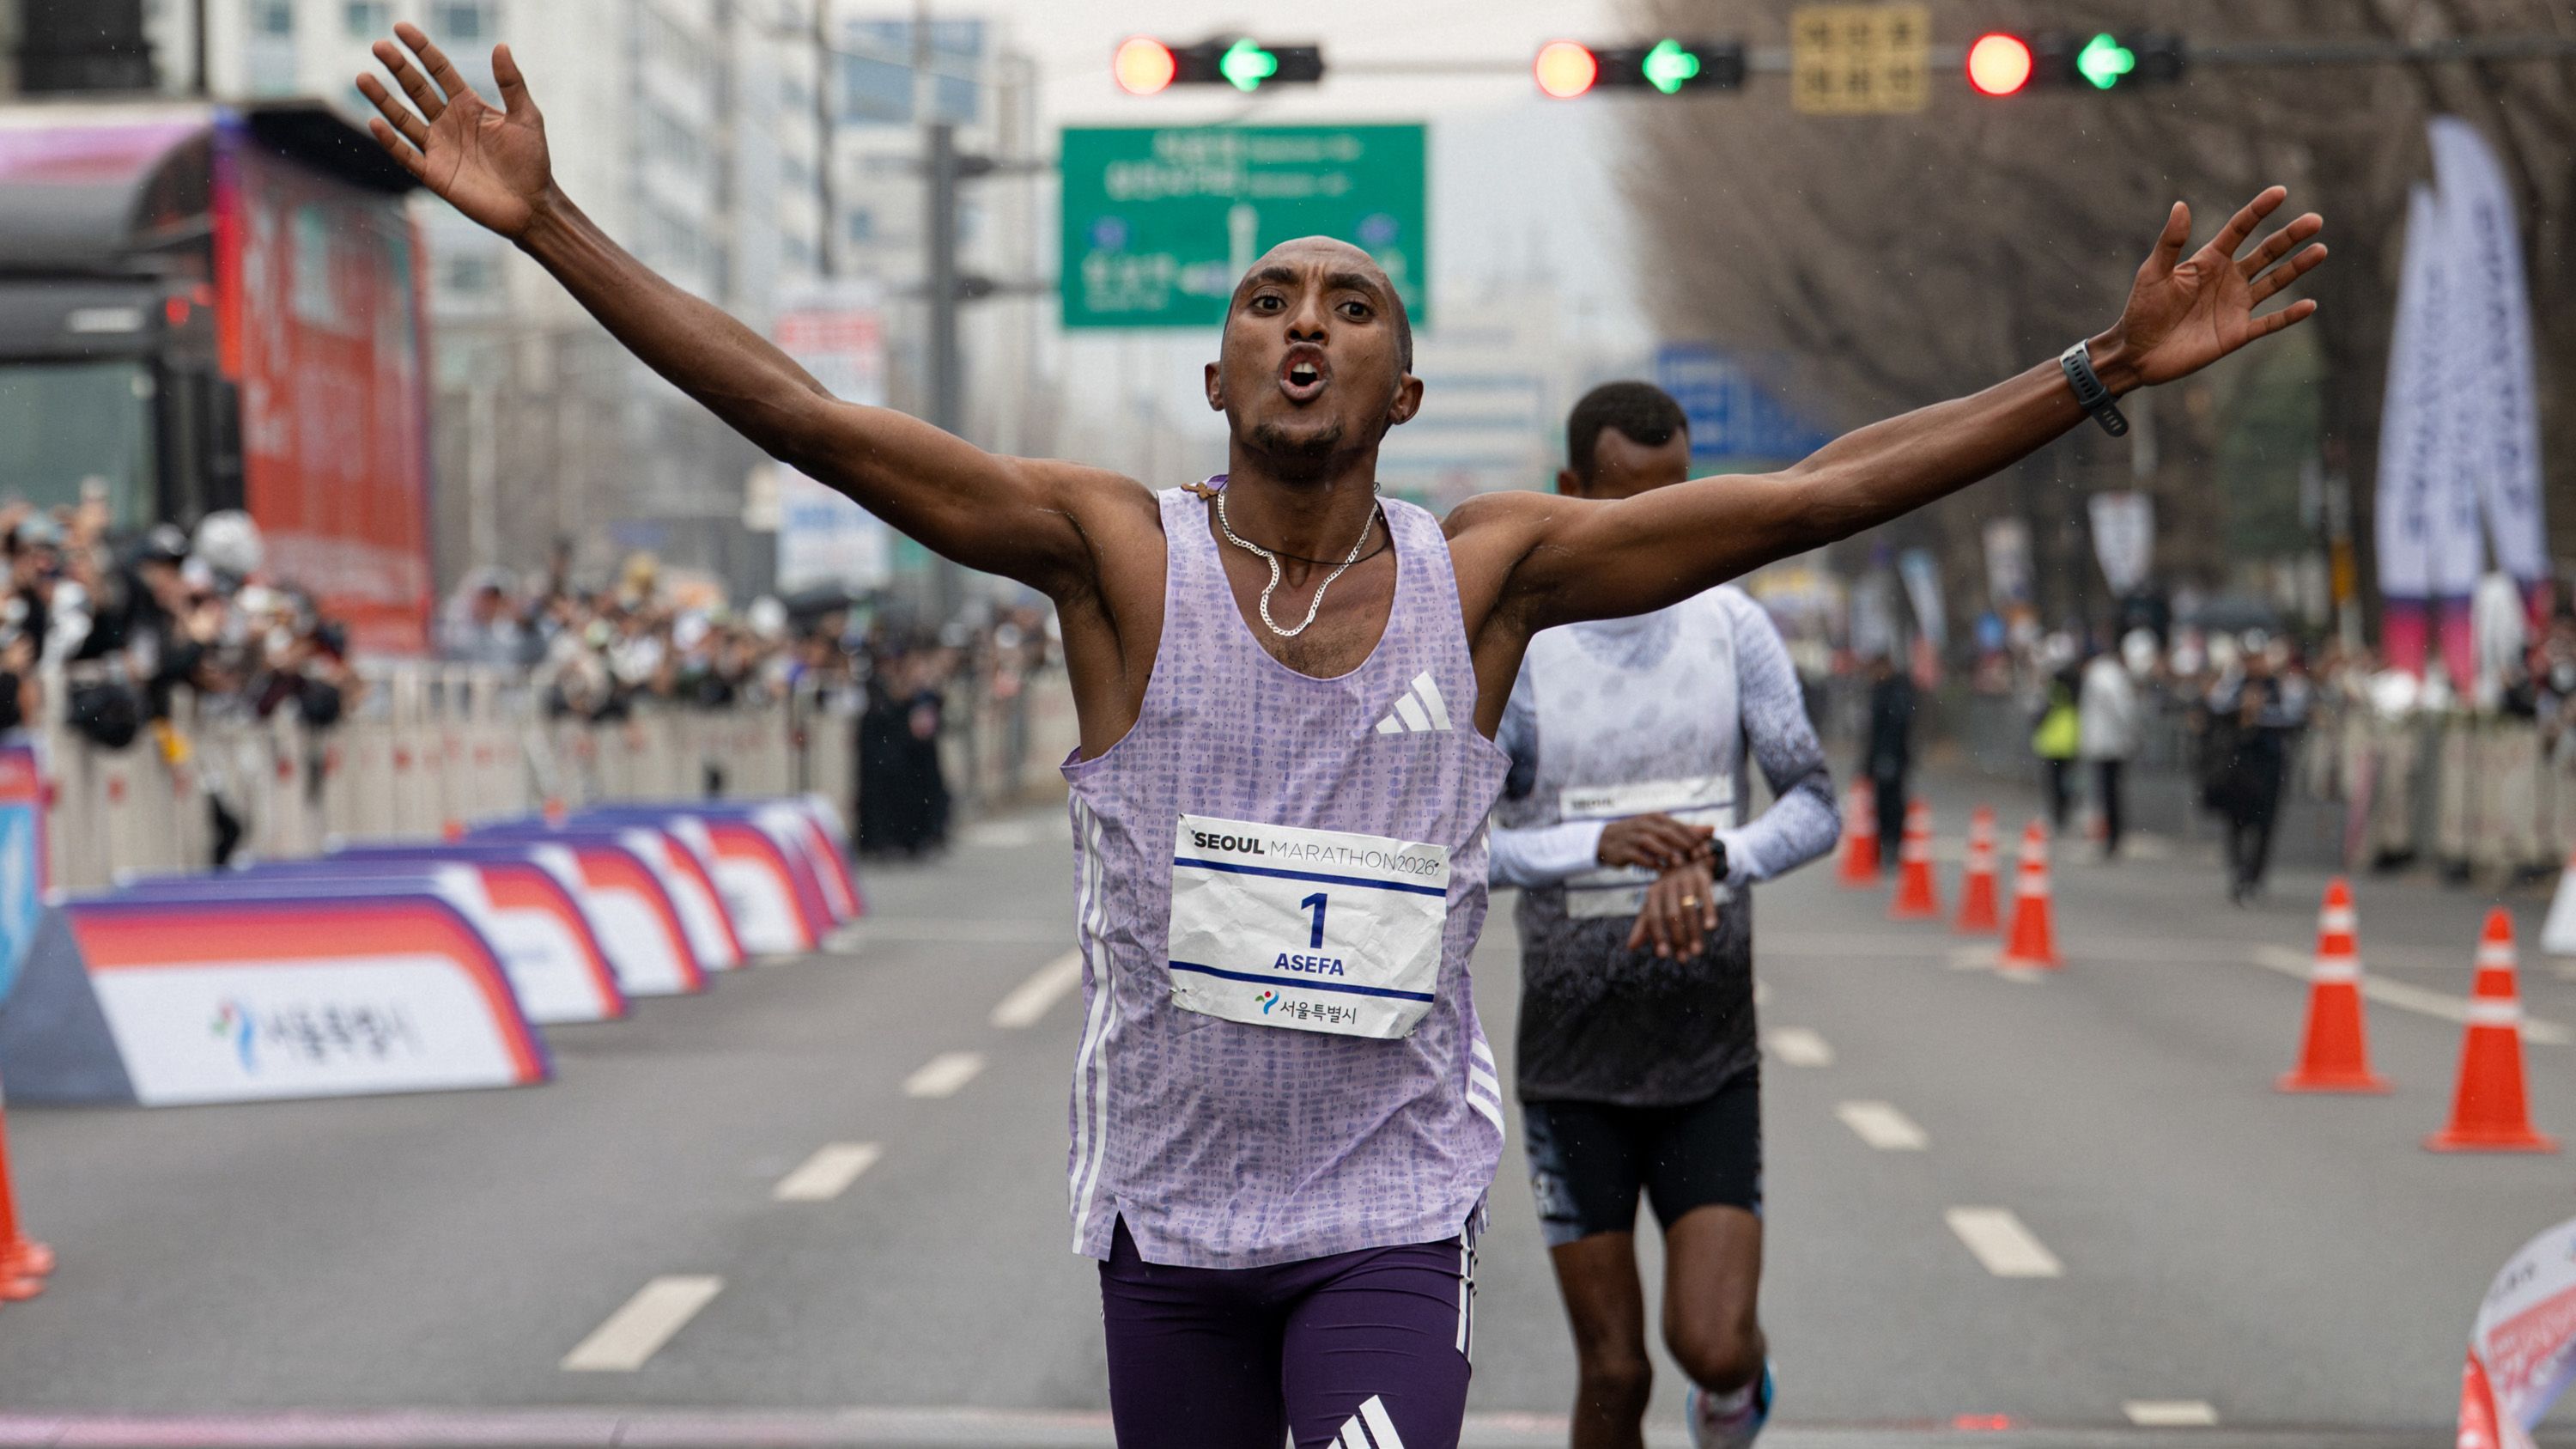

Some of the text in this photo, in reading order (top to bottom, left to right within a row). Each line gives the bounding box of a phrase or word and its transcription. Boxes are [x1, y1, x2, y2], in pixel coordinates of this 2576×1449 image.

[1194, 831, 1265, 855] SEOUL
[1301, 892, 1328, 949] 1
[1273, 953, 1345, 977] ASEFA
[1279, 1000, 1357, 1025] 서울특별시
